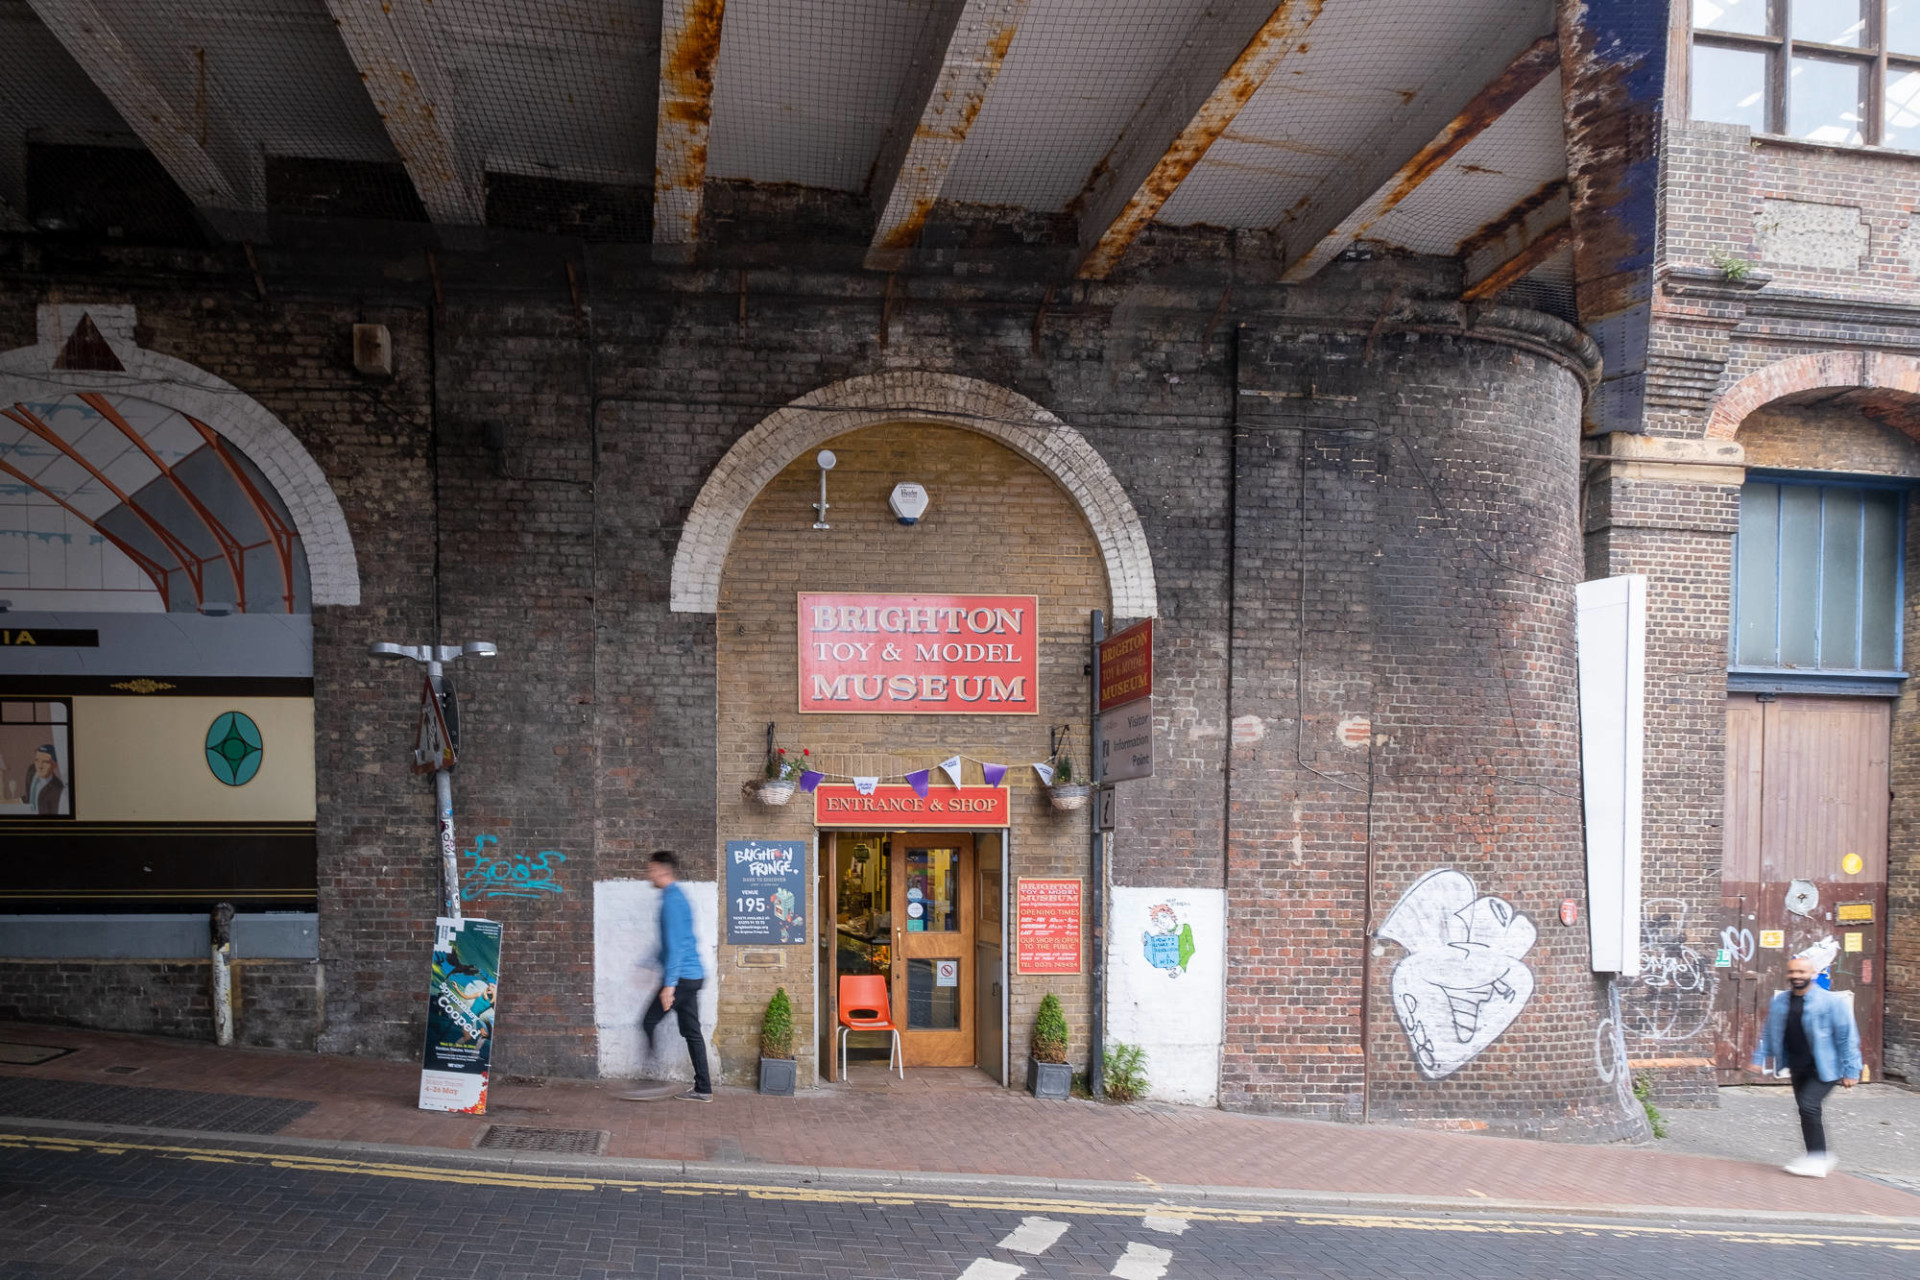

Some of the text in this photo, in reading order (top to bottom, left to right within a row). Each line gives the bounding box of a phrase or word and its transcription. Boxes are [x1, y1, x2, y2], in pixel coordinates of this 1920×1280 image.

[811, 605, 1024, 634] BRIGHTON
[813, 642, 1022, 663] TOY & MODEL
[1102, 631, 1148, 664] BRIGHTON
[1121, 653, 1147, 675] MODEL
[811, 674, 1027, 703] MUSEUM
[1102, 671, 1149, 702] MUSEUM
[1128, 714, 1149, 729] Visitor
[1114, 734, 1149, 752] Information
[1132, 753, 1150, 767] Point
[826, 797, 998, 813] ENTRANCE & SHOP
[736, 897, 766, 913] 195
[1020, 909, 1080, 917] OPENING TIMES
[438, 996, 481, 1040] Cooped
